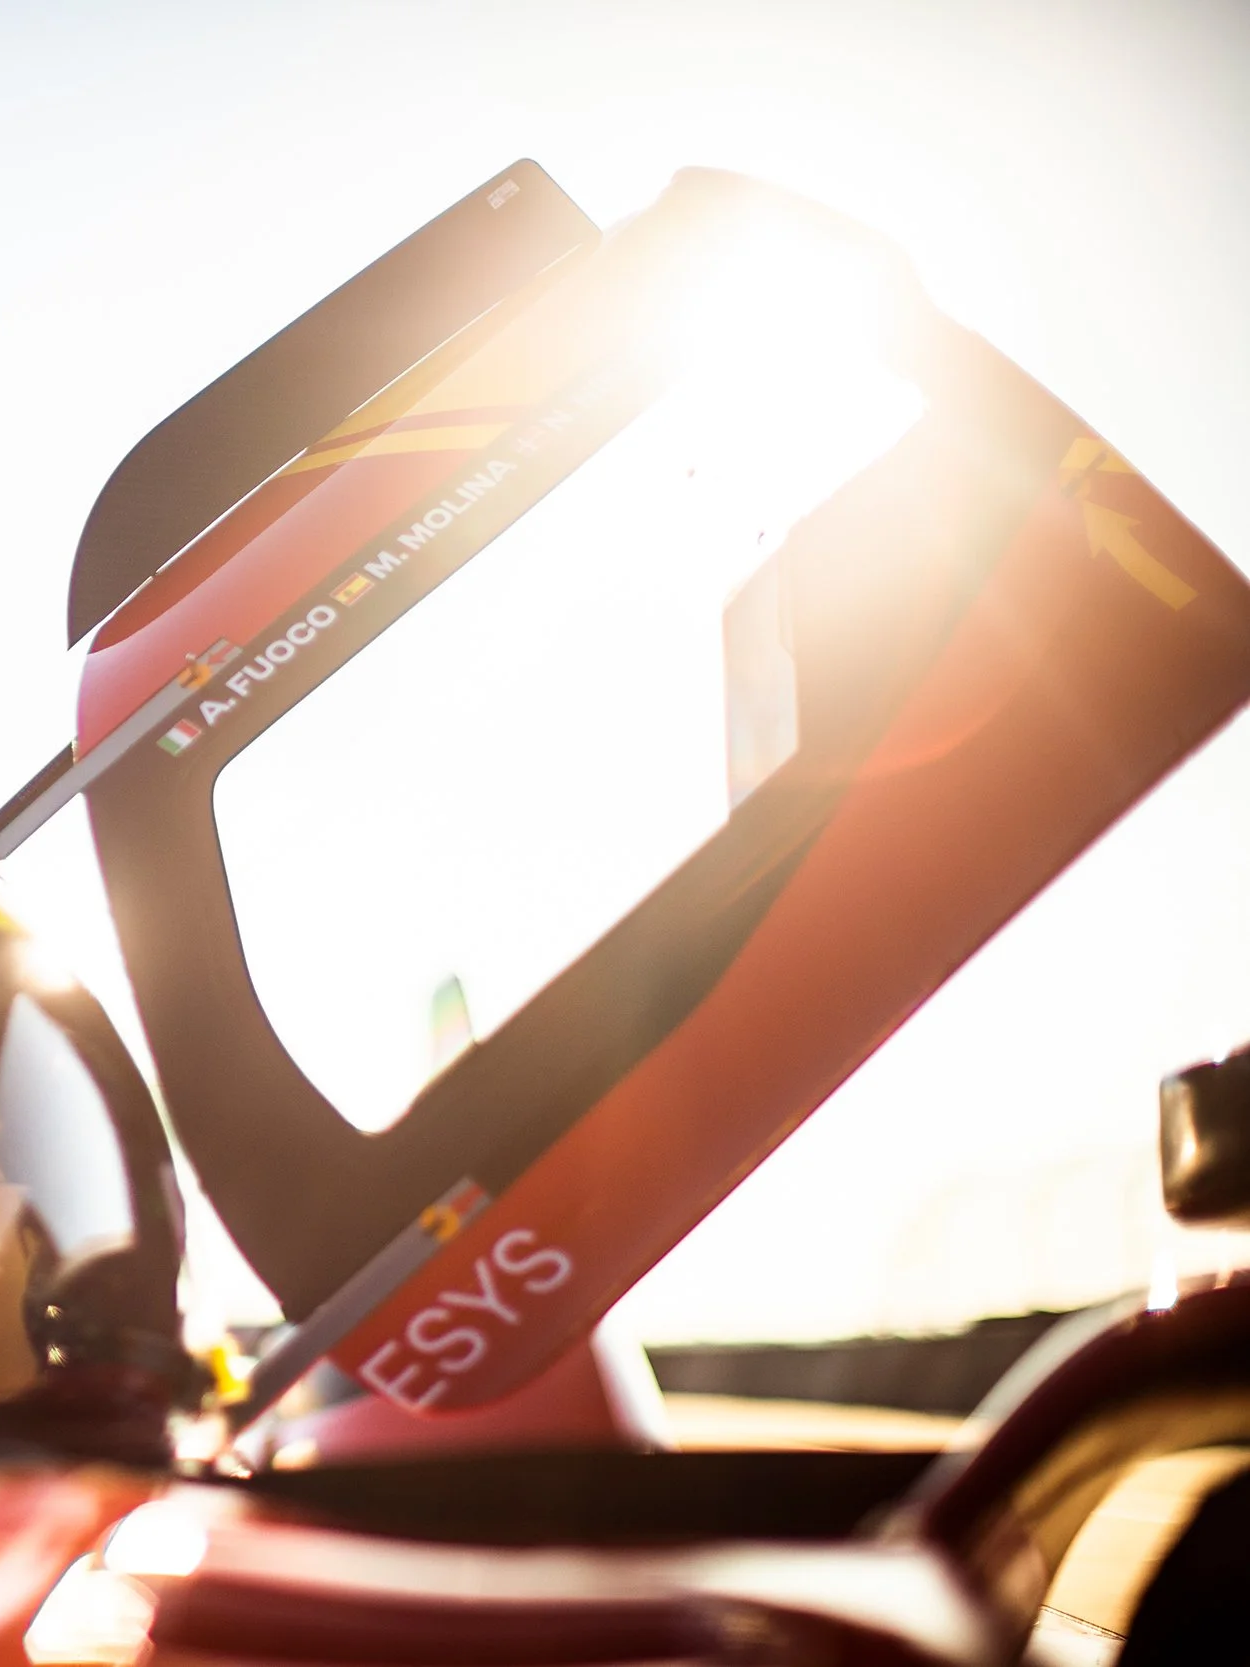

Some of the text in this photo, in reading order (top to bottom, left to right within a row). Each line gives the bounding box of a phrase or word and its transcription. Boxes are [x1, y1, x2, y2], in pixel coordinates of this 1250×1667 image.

[200, 698, 237, 726] A.
[226, 605, 336, 696] FUOCO
[364, 550, 409, 580] M.
[397, 460, 517, 550] MOLINA
[357, 1230, 573, 1412] ESYS
